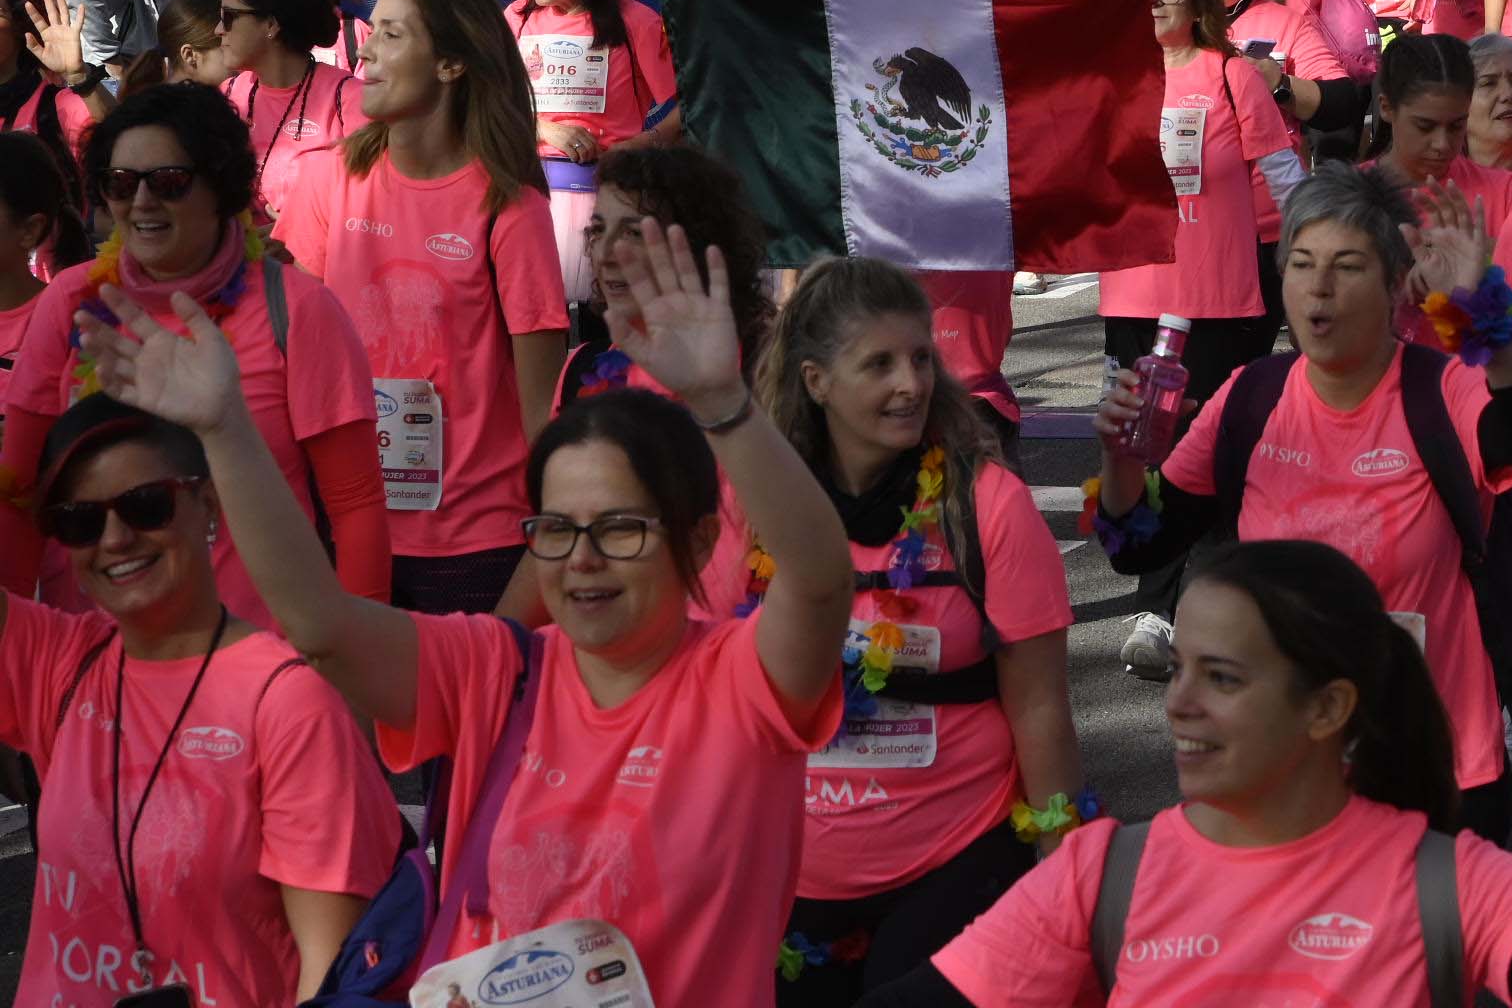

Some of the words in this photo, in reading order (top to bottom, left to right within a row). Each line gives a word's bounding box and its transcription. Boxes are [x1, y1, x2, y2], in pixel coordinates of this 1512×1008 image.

[547, 64, 577, 76] 016
[551, 78, 570, 86] 2833
[386, 489, 432, 500] Santander
[870, 743, 924, 755] Santander
[1126, 933, 1220, 963] OYSHO
[487, 964, 570, 1001] ASTURIANA
